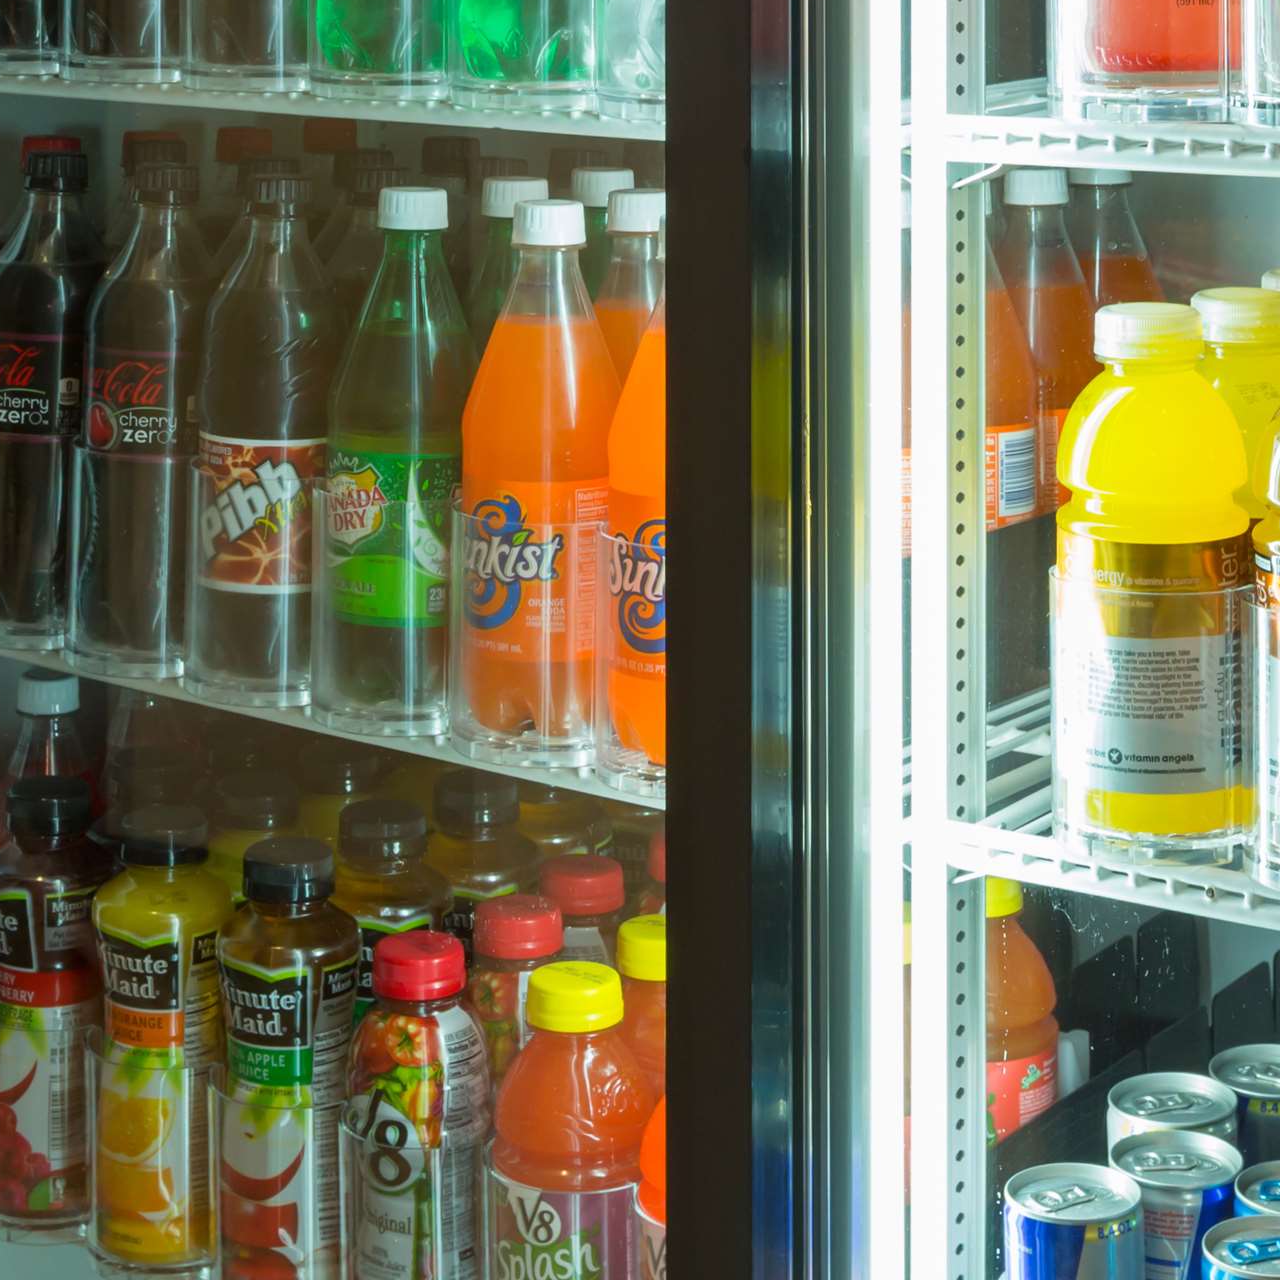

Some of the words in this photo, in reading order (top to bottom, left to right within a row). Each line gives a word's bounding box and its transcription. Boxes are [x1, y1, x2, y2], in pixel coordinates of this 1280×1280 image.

[118, 412, 179, 433] cherry
[122, 428, 170, 445] zero
[201, 458, 304, 559] Pibb
[333, 509, 367, 533] DRY
[1123, 753, 1160, 763] vitamin
[1161, 752, 1196, 765] angels
[247, 1050, 287, 1068] APPLE
[1259, 1101, 1280, 1114] 8.4
[516, 1195, 555, 1245] V8
[496, 1240, 601, 1280] Splash
